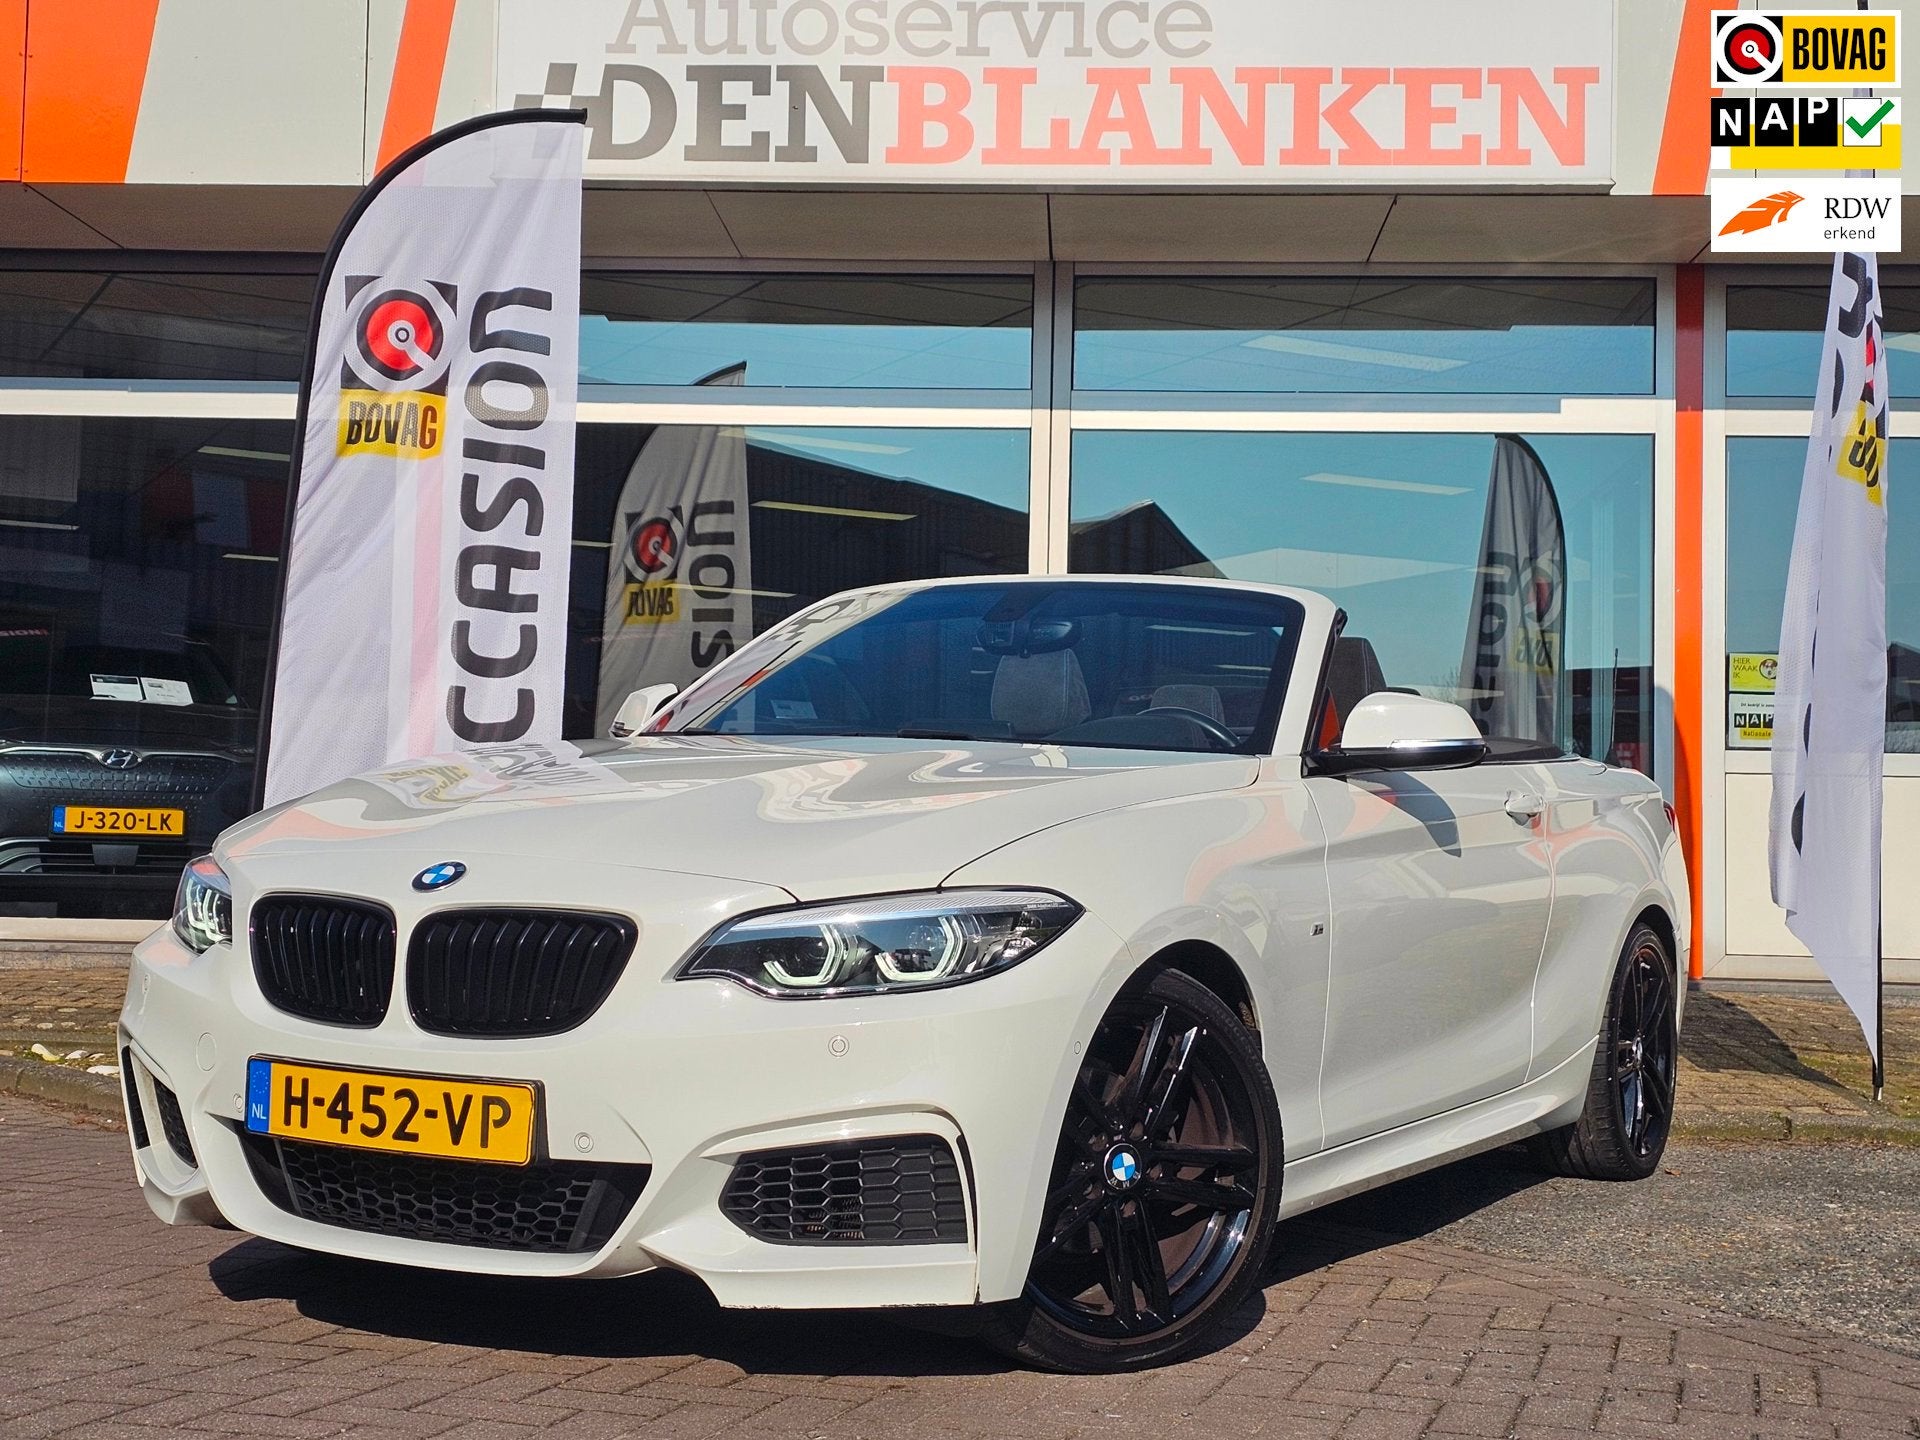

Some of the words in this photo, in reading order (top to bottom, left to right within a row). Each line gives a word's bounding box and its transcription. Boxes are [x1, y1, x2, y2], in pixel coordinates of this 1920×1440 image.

[605, 0, 1213, 58] Autoservice
[346, 399, 437, 450] BOVAG
[1733, 664, 1758, 672] WAAK
[74, 811, 173, 832] J-320-LK
[252, 1103, 267, 1120] NL
[283, 1075, 512, 1149] H-452-VP
